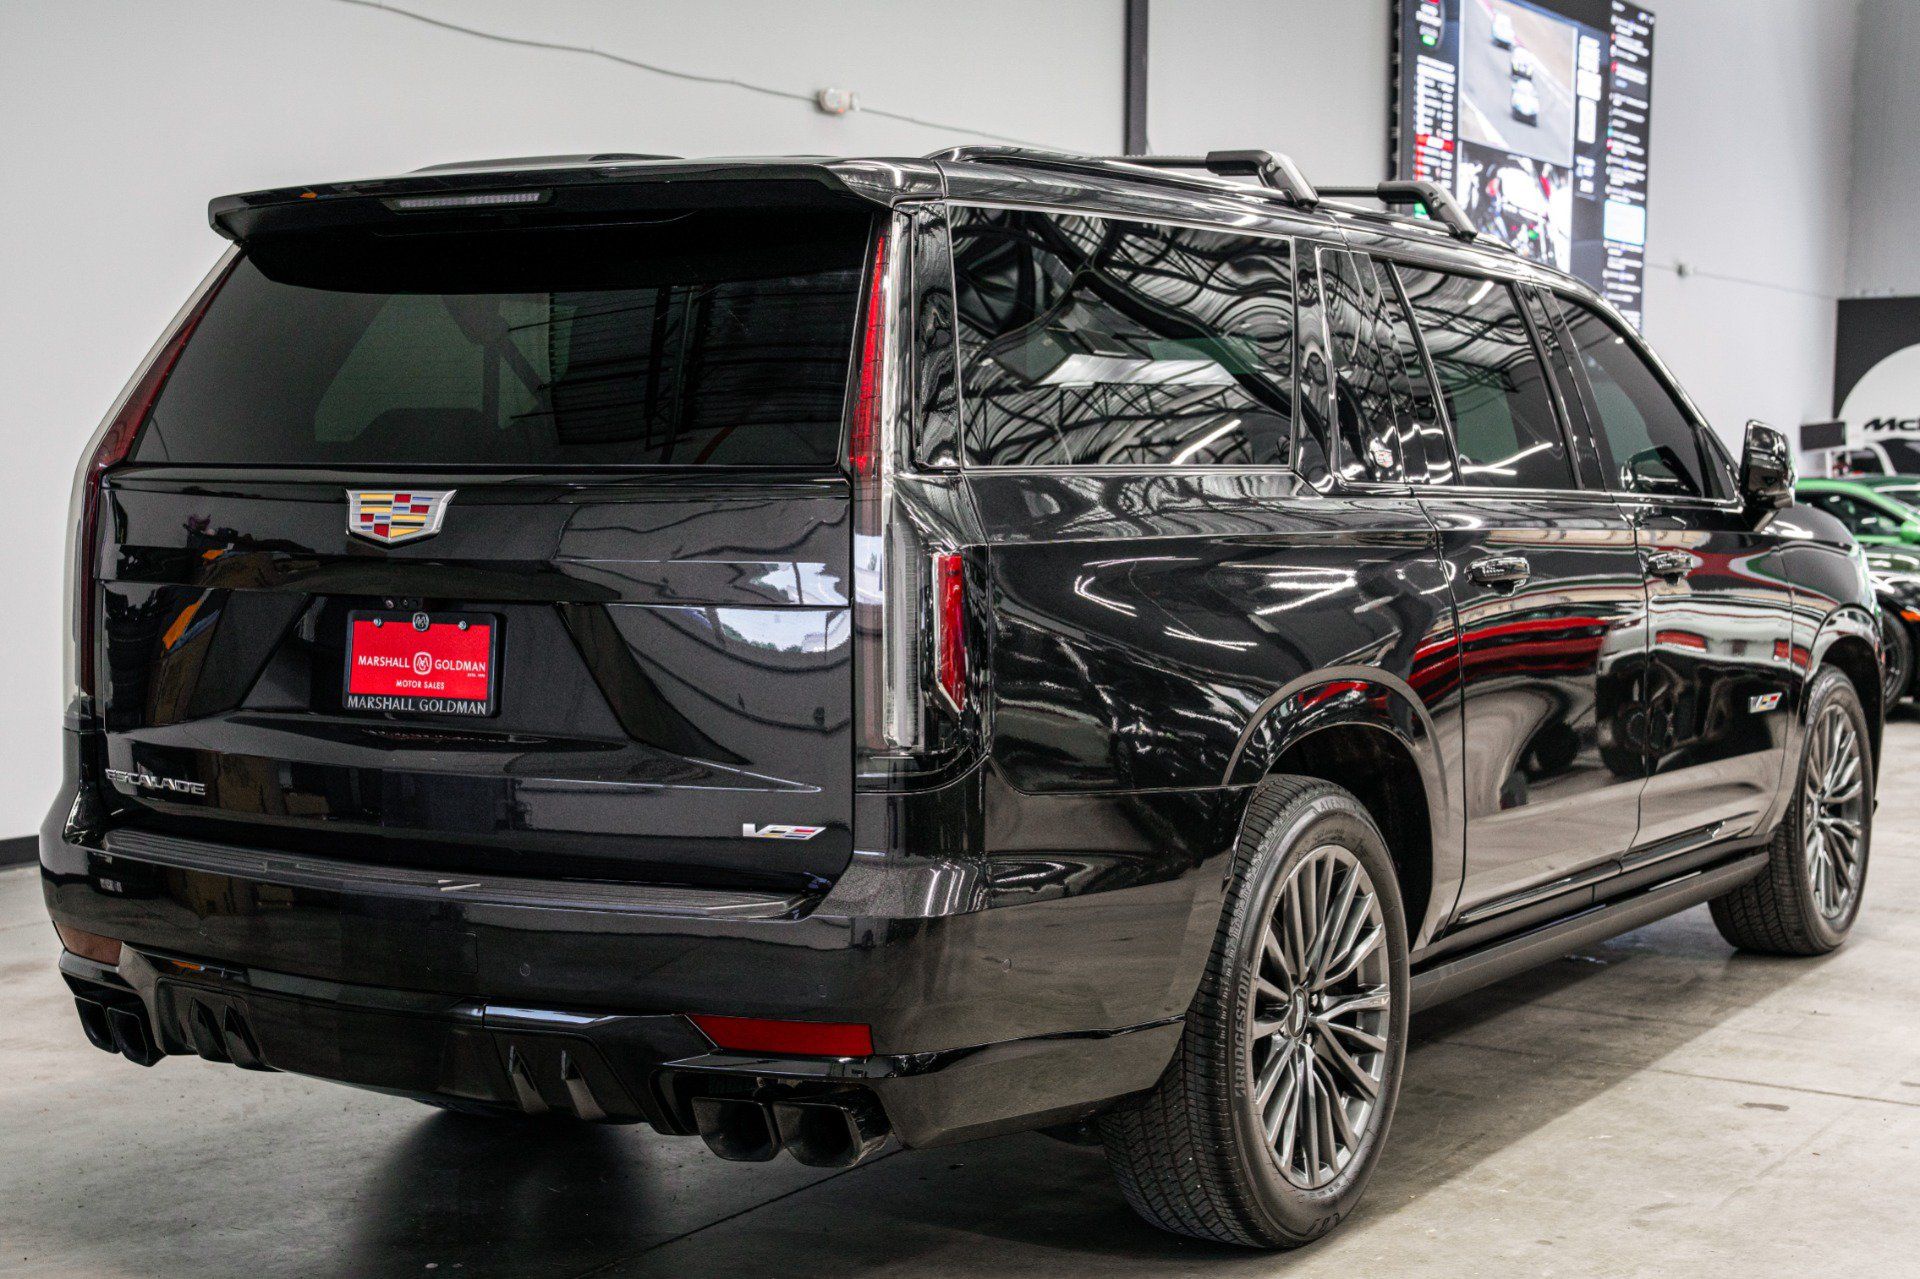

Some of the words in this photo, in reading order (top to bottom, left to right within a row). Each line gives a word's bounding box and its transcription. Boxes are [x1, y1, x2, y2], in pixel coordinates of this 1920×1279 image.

[1864, 418, 1920, 431] Mc
[358, 655, 410, 669] MARSHALL
[434, 659, 486, 672] GOLDMAN
[395, 679, 422, 689] MOTOR
[424, 681, 445, 691] SALES
[347, 695, 415, 712] MARSHALL
[419, 698, 487, 716] GOLDMAN
[105, 768, 206, 796] ESCALADE
